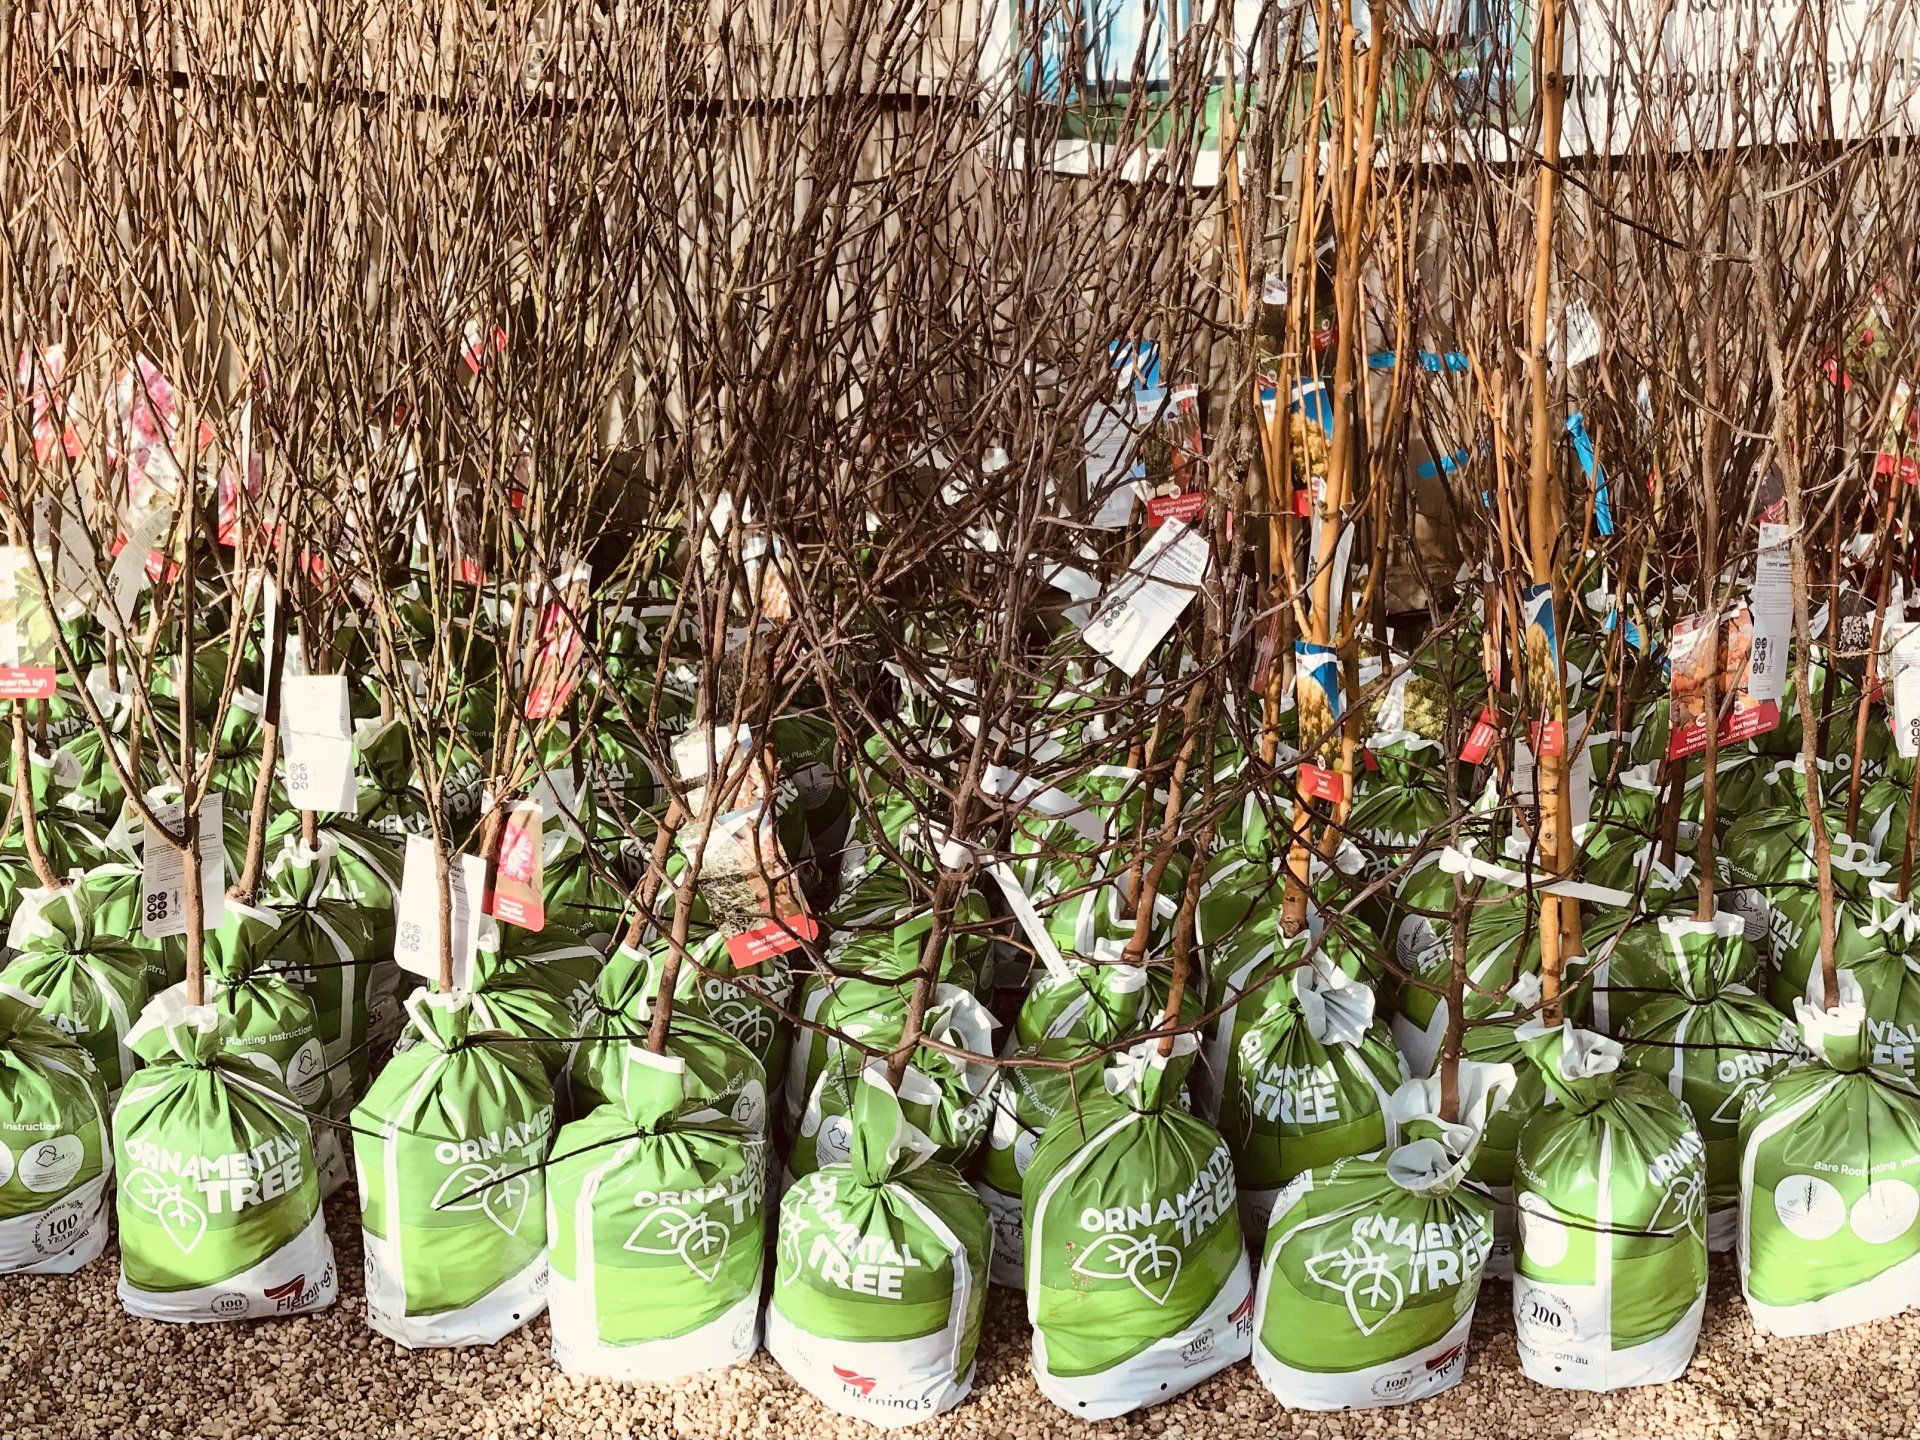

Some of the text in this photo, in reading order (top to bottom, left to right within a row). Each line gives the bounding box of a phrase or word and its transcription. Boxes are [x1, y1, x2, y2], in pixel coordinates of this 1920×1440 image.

[225, 1035, 267, 1047] Planting
[1253, 1081, 1341, 1124] TREE
[1813, 1161, 1840, 1174] Bare
[198, 1155, 304, 1214] TREE
[1175, 1171, 1237, 1249] TREE
[47, 1213, 78, 1238] 100
[807, 1232, 906, 1300] TREE
[1408, 1228, 1494, 1295] TREE
[219, 1299, 244, 1308] 100
[1531, 1302, 1562, 1329] 100
[1384, 1376, 1408, 1389] 100
